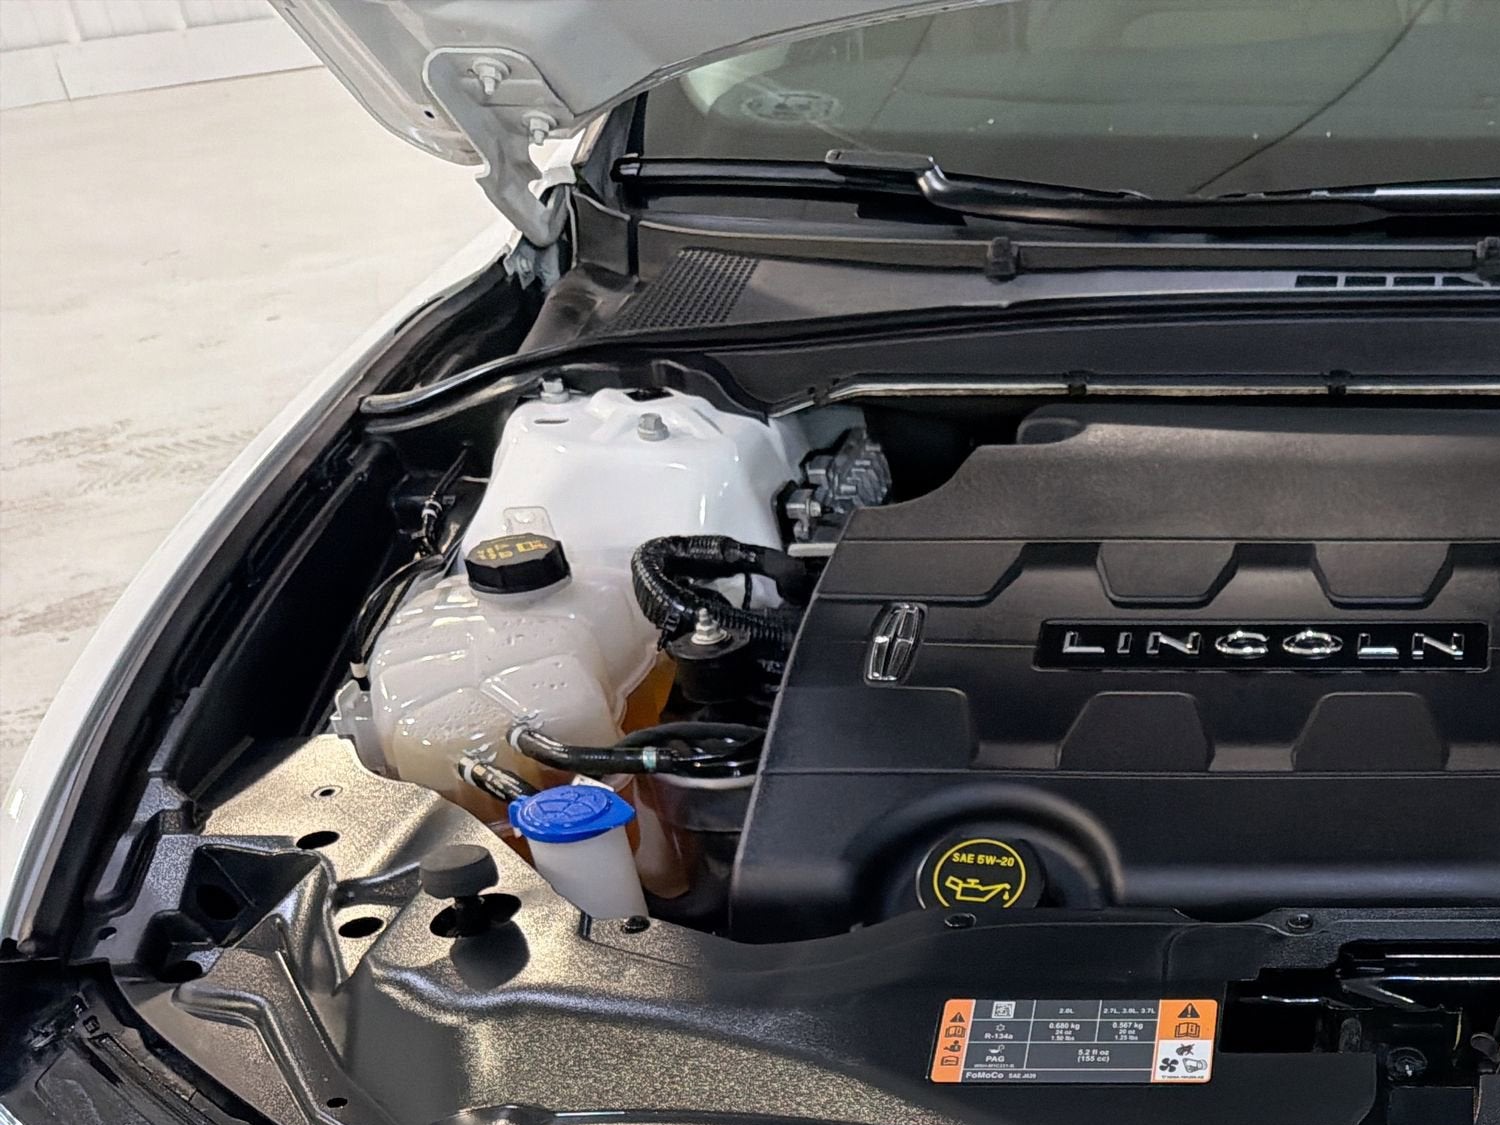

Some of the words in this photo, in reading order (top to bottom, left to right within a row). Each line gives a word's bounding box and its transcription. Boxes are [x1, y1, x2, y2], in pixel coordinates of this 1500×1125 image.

[1062, 631, 1465, 660] LINCOLN
[952, 852, 975, 864] SAE
[977, 854, 1015, 867] 5W-20
[1070, 1022, 1081, 1031] kg
[1133, 1022, 1144, 1031] kg
[984, 1032, 1014, 1040] R-134a
[985, 1055, 1005, 1063] PAG
[1077, 1055, 1095, 1063] (155
[1096, 1055, 1110, 1063] cc)
[965, 1071, 1004, 1079] FoMoCo
